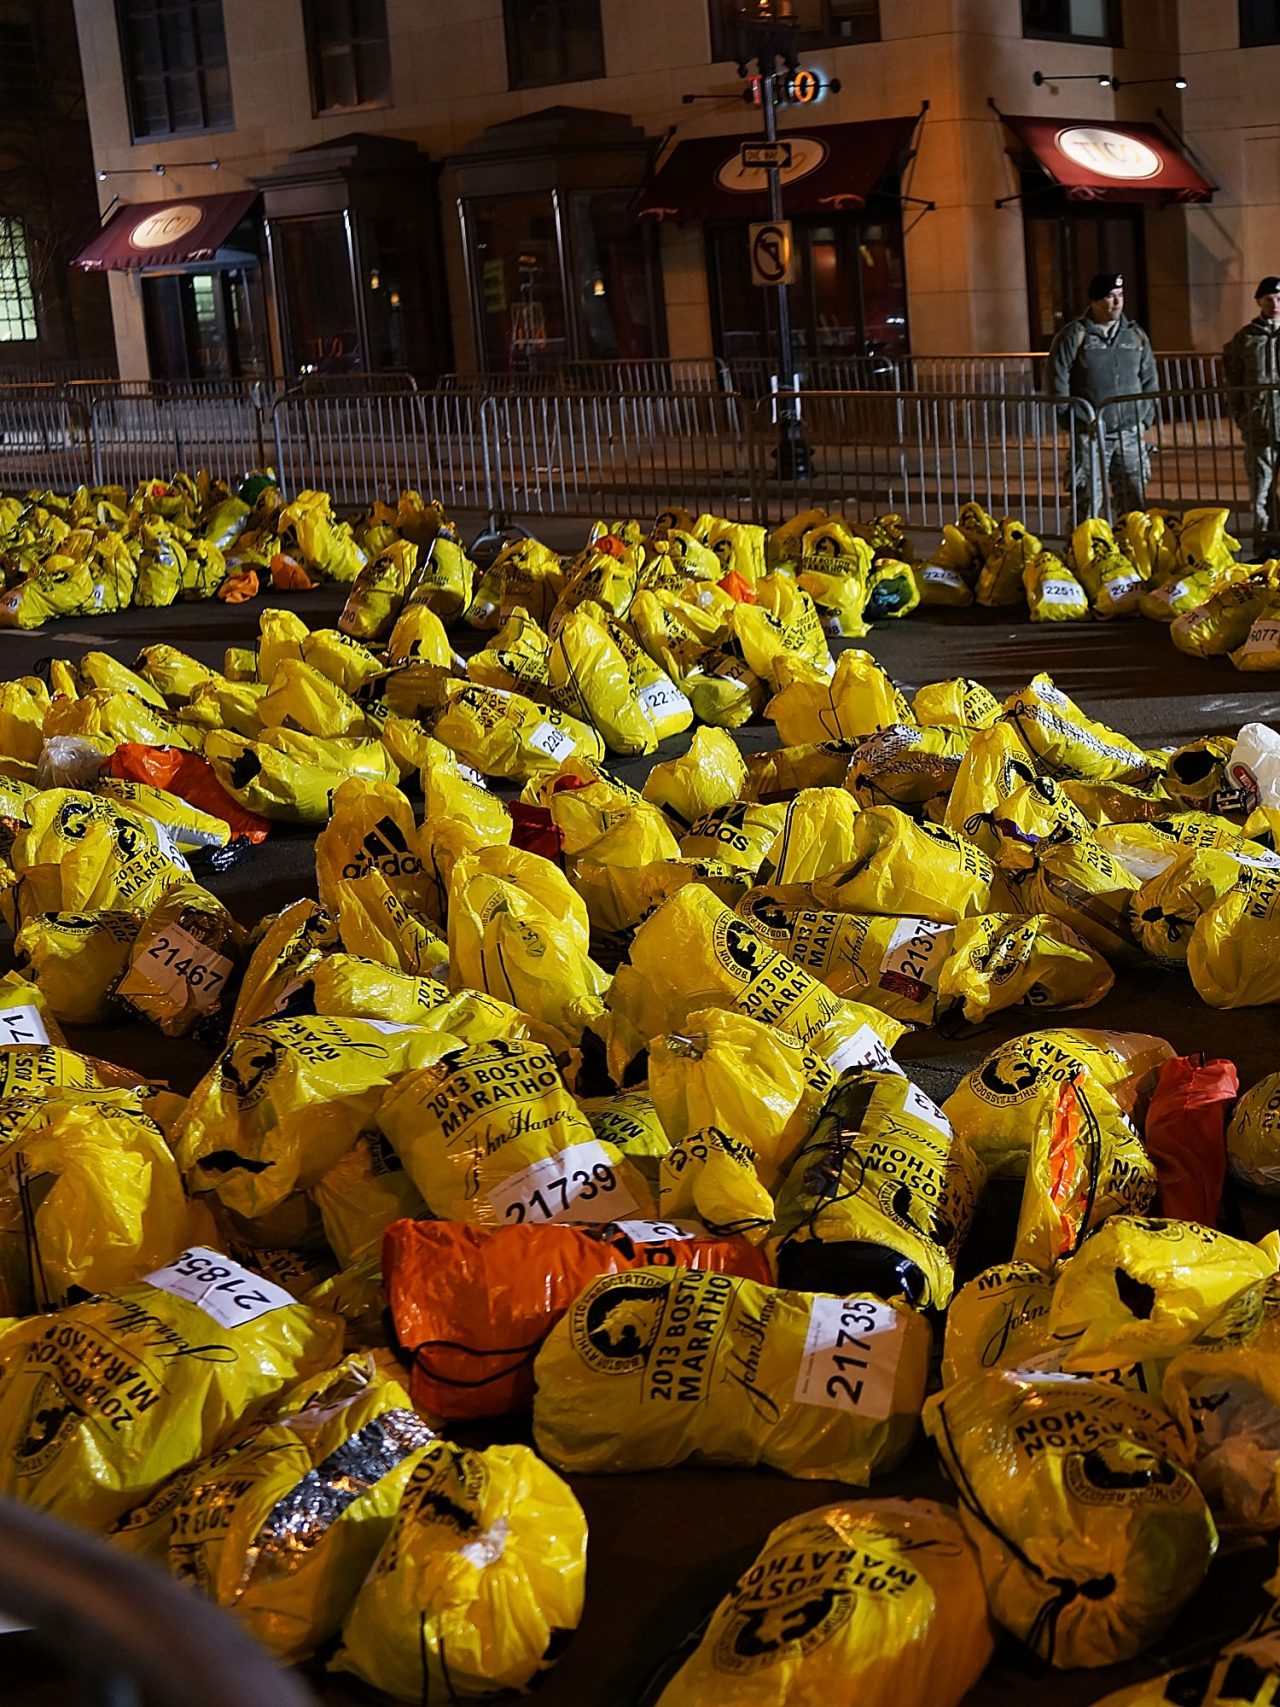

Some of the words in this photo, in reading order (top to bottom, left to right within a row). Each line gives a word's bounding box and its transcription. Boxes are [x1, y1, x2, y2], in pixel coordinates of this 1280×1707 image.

[112, 860, 144, 886] 2013
[118, 855, 169, 898] MARAT
[147, 937, 224, 993] 21467
[792, 926, 814, 964] 2013
[808, 913, 839, 969] MARA
[738, 978, 777, 1018] 2013
[760, 967, 816, 1026] MARAT
[284, 1032, 326, 1065] 2013
[291, 1016, 343, 1062] MARA
[1025, 1035, 1081, 1074] MARA
[426, 1072, 471, 1118] 2013
[440, 1070, 557, 1139] MARATHO
[869, 1142, 948, 1192] ATHON
[505, 1161, 618, 1224] 21739
[676, 1272, 732, 1401] MARATHO
[826, 1300, 878, 1405] 21735
[650, 1343, 682, 1400] 2013
[719, 1338, 782, 1425] John
[1024, 1424, 1100, 1457] STON
